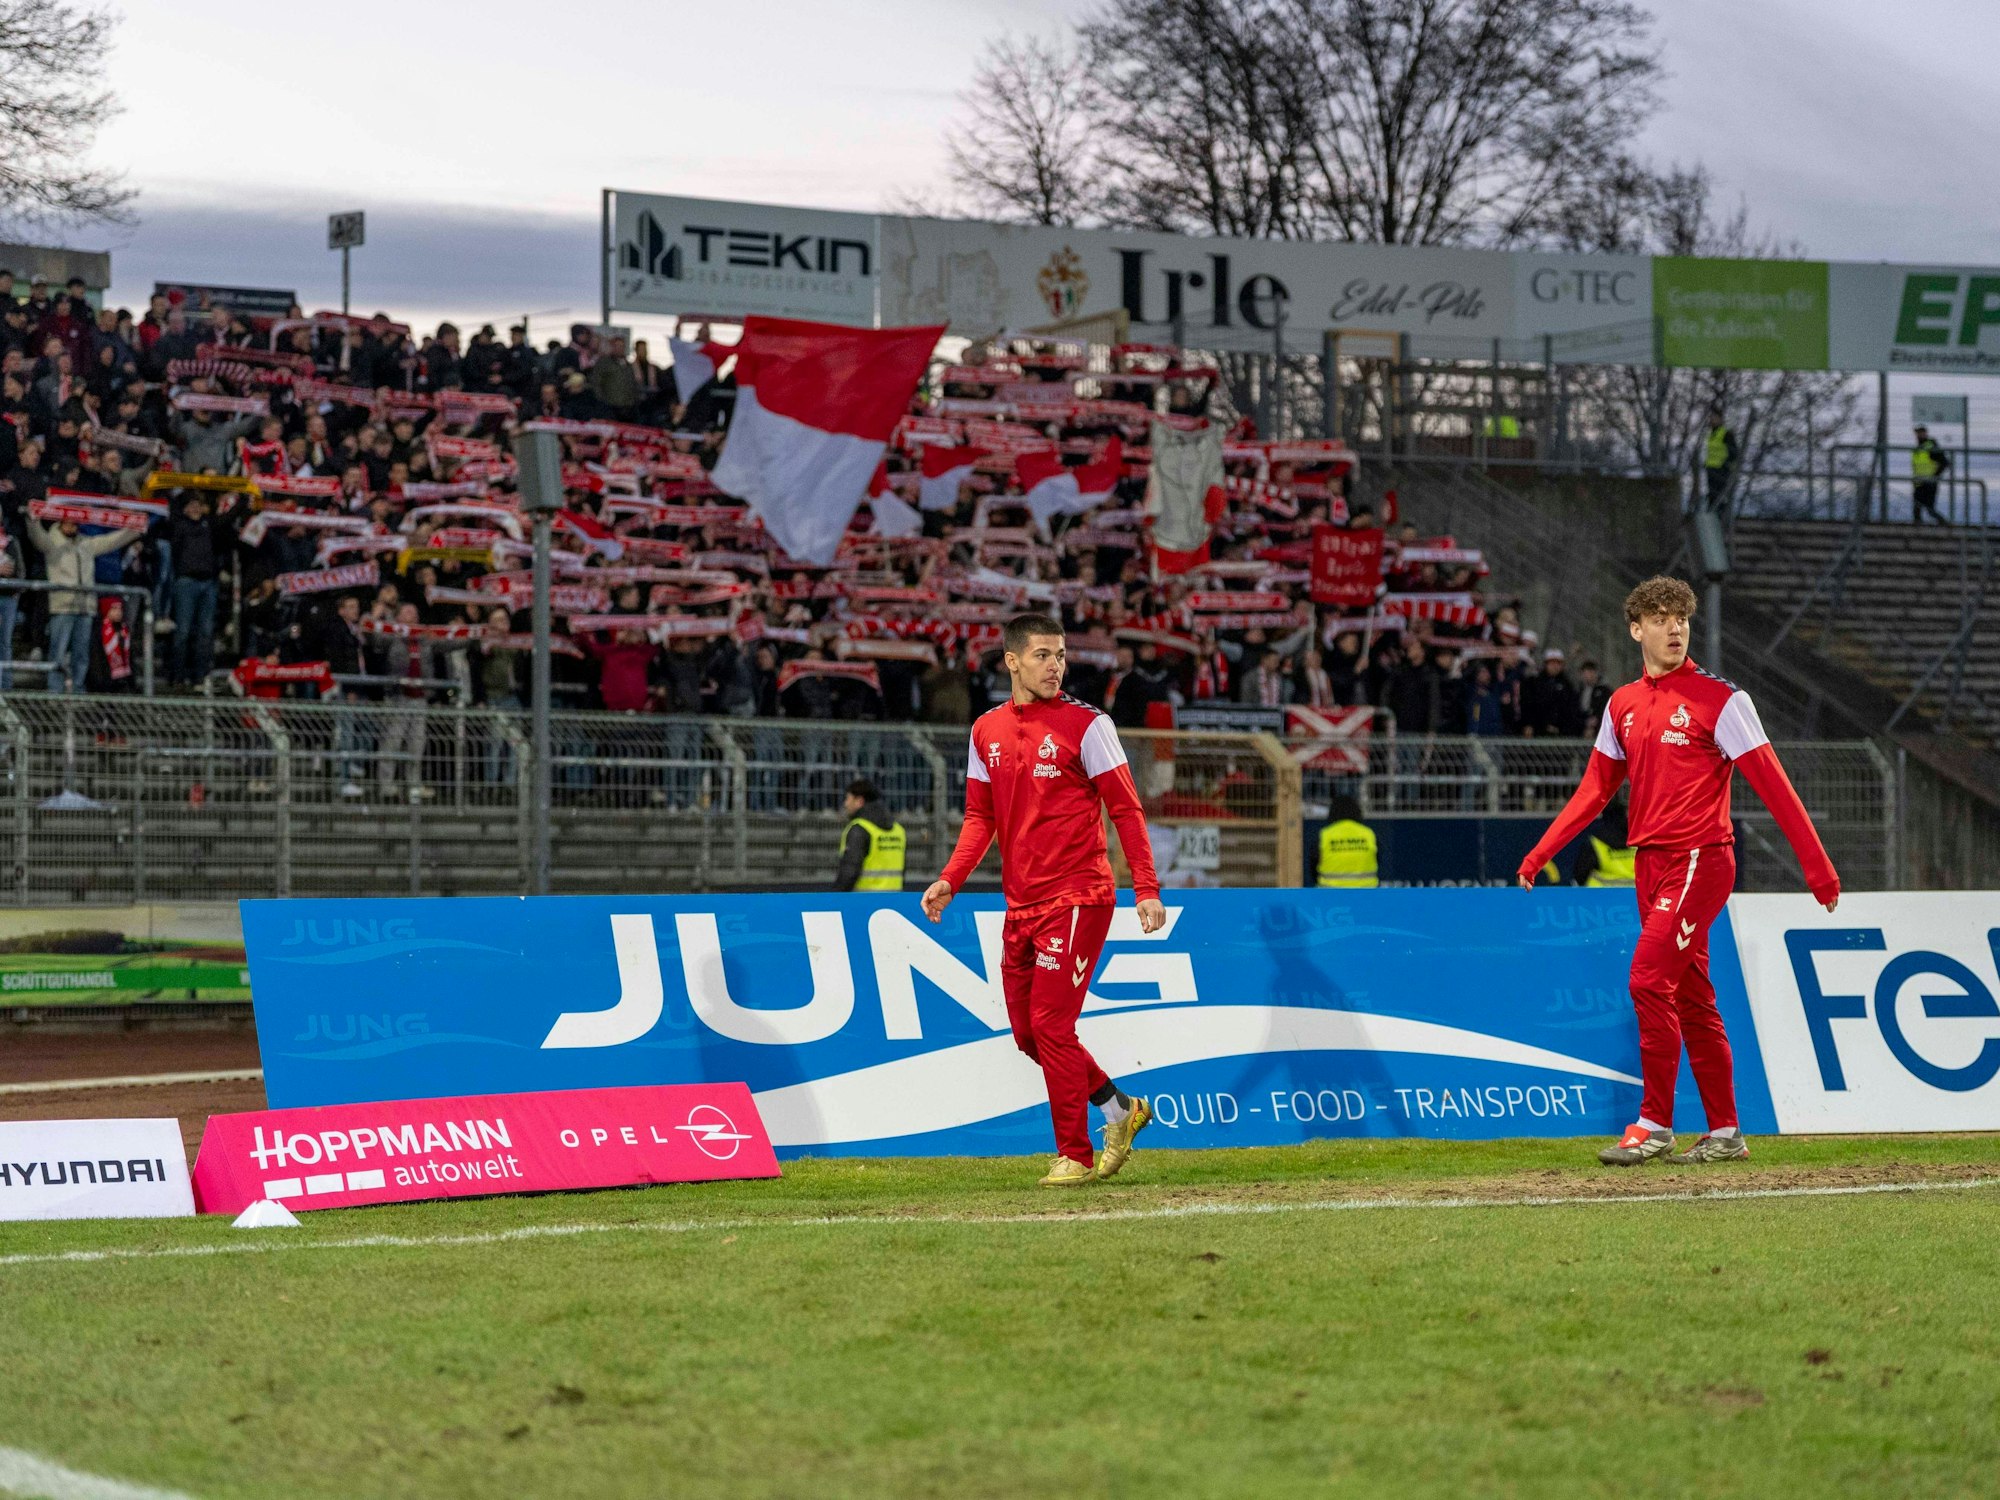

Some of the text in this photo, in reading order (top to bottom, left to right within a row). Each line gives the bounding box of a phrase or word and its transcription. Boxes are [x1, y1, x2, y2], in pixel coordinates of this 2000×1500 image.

[683, 224, 871, 276] TEKIN
[1110, 246, 1291, 330] Irle
[1329, 277, 1486, 325] Edel-Pils
[1660, 735, 1690, 746] Energie
[1663, 730, 1686, 740] Rhein
[1033, 769, 1061, 778] Energie
[1035, 763, 1057, 772] Rhein
[1, 971, 118, 990] SCHÜTTGUTHANDEL
[1546, 988, 1633, 1013] JUN
[1784, 928, 2000, 1092] Fe
[1143, 1093, 1239, 1129] QUID
[1270, 1090, 1367, 1122] FOOD
[1392, 1084, 1589, 1120] TRANSPORT
[250, 1118, 514, 1171] HOPPMANN
[559, 1124, 668, 1149] OPEL
[394, 1152, 524, 1187] autowelt
